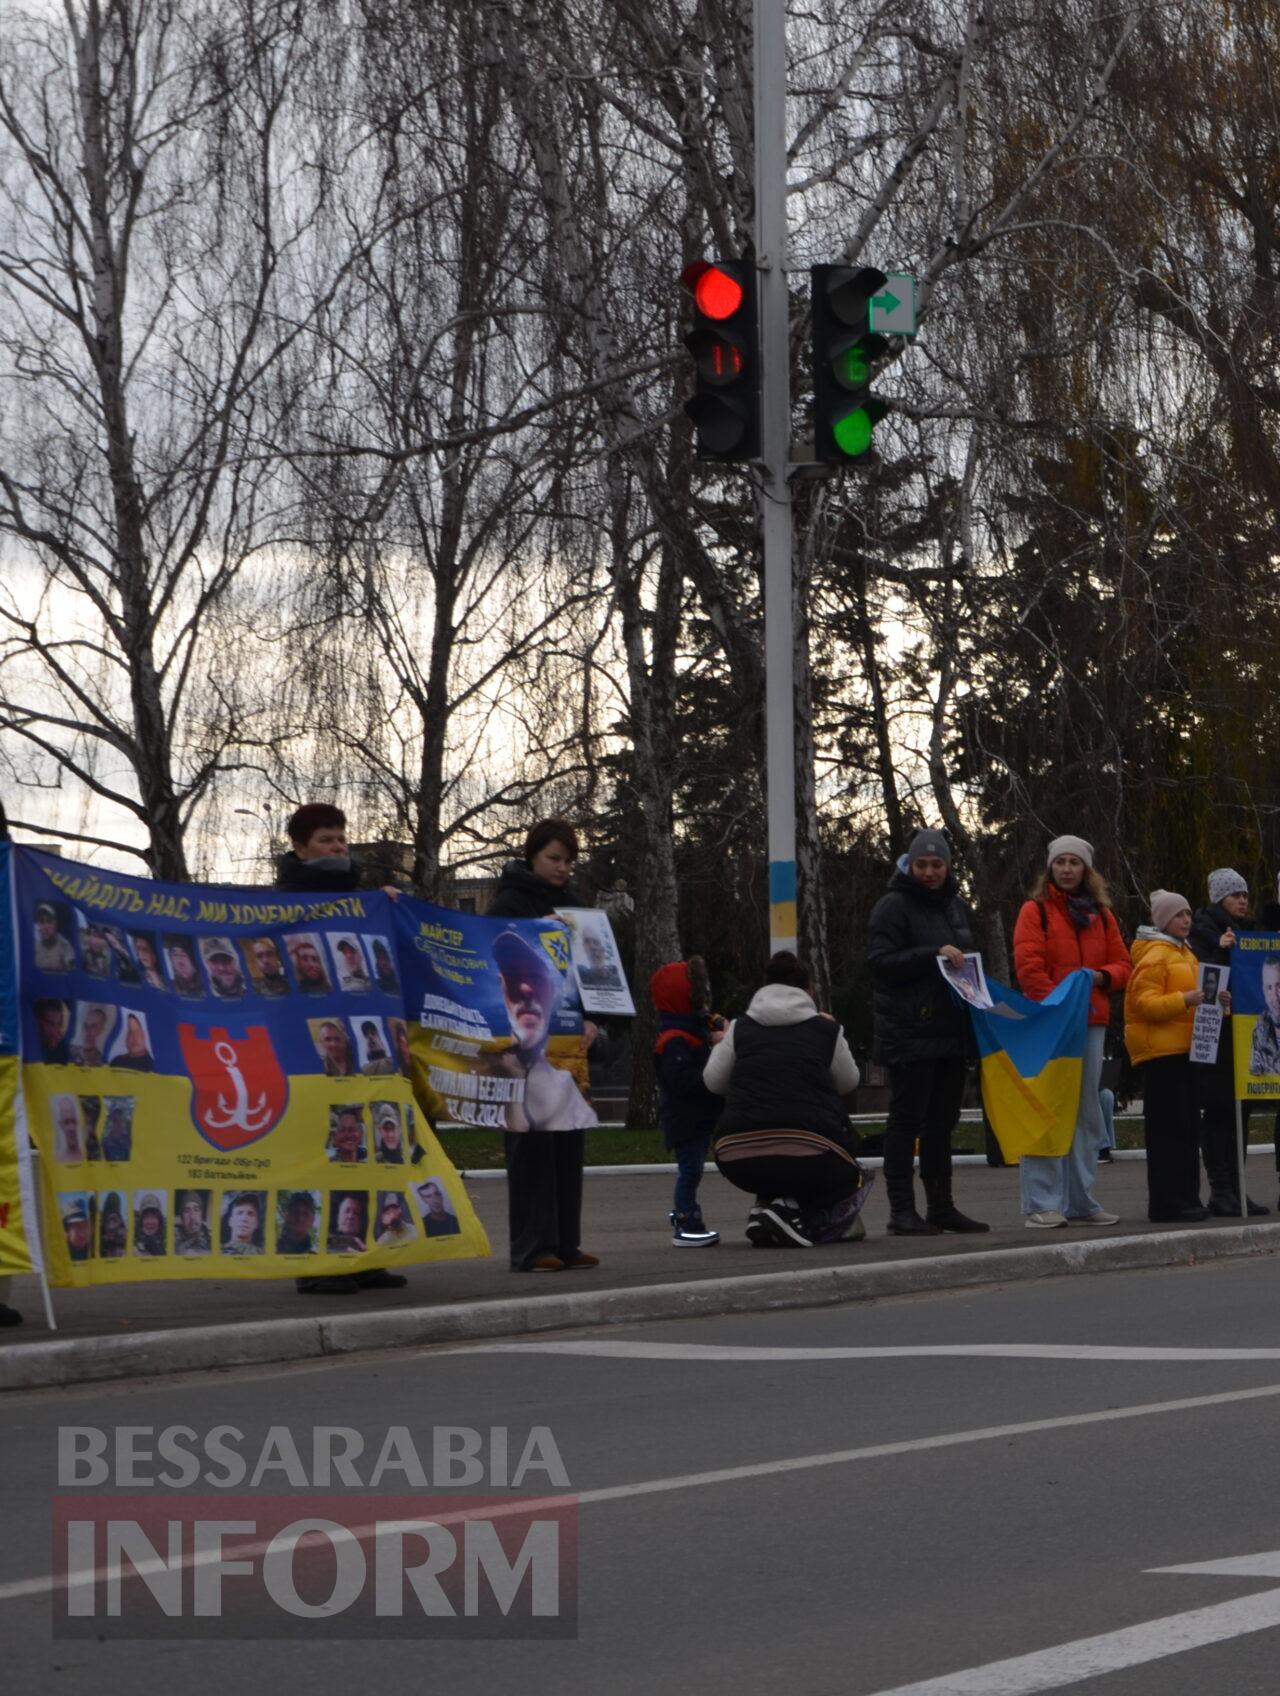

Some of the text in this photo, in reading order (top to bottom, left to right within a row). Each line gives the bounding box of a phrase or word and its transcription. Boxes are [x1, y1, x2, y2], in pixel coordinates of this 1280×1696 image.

[146, 895, 191, 920] НАС,
[196, 900, 228, 922] МИ
[230, 903, 303, 925] ХОЧЕМО
